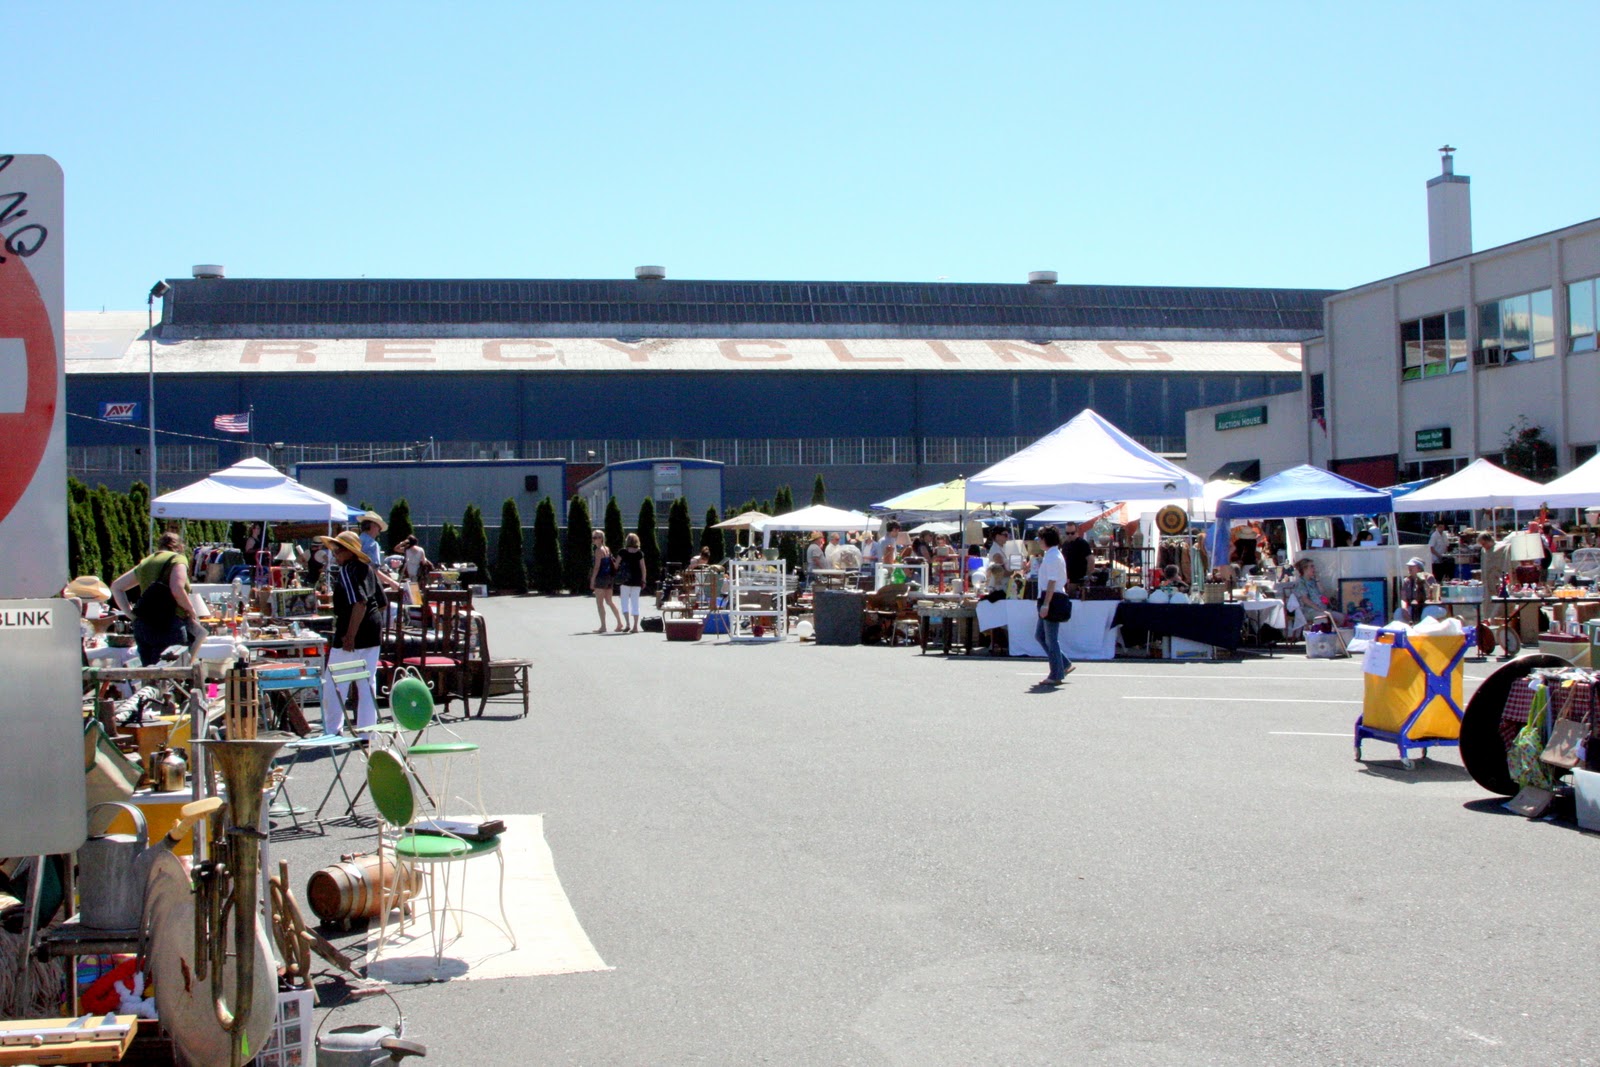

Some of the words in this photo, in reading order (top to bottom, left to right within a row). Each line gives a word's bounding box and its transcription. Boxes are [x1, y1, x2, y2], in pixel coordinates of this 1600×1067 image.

[239, 339, 1174, 364] RECYCLING
[1217, 419, 1241, 430] AUCTION
[1241, 416, 1262, 426] HOUSE
[0, 611, 51, 626] LINK
